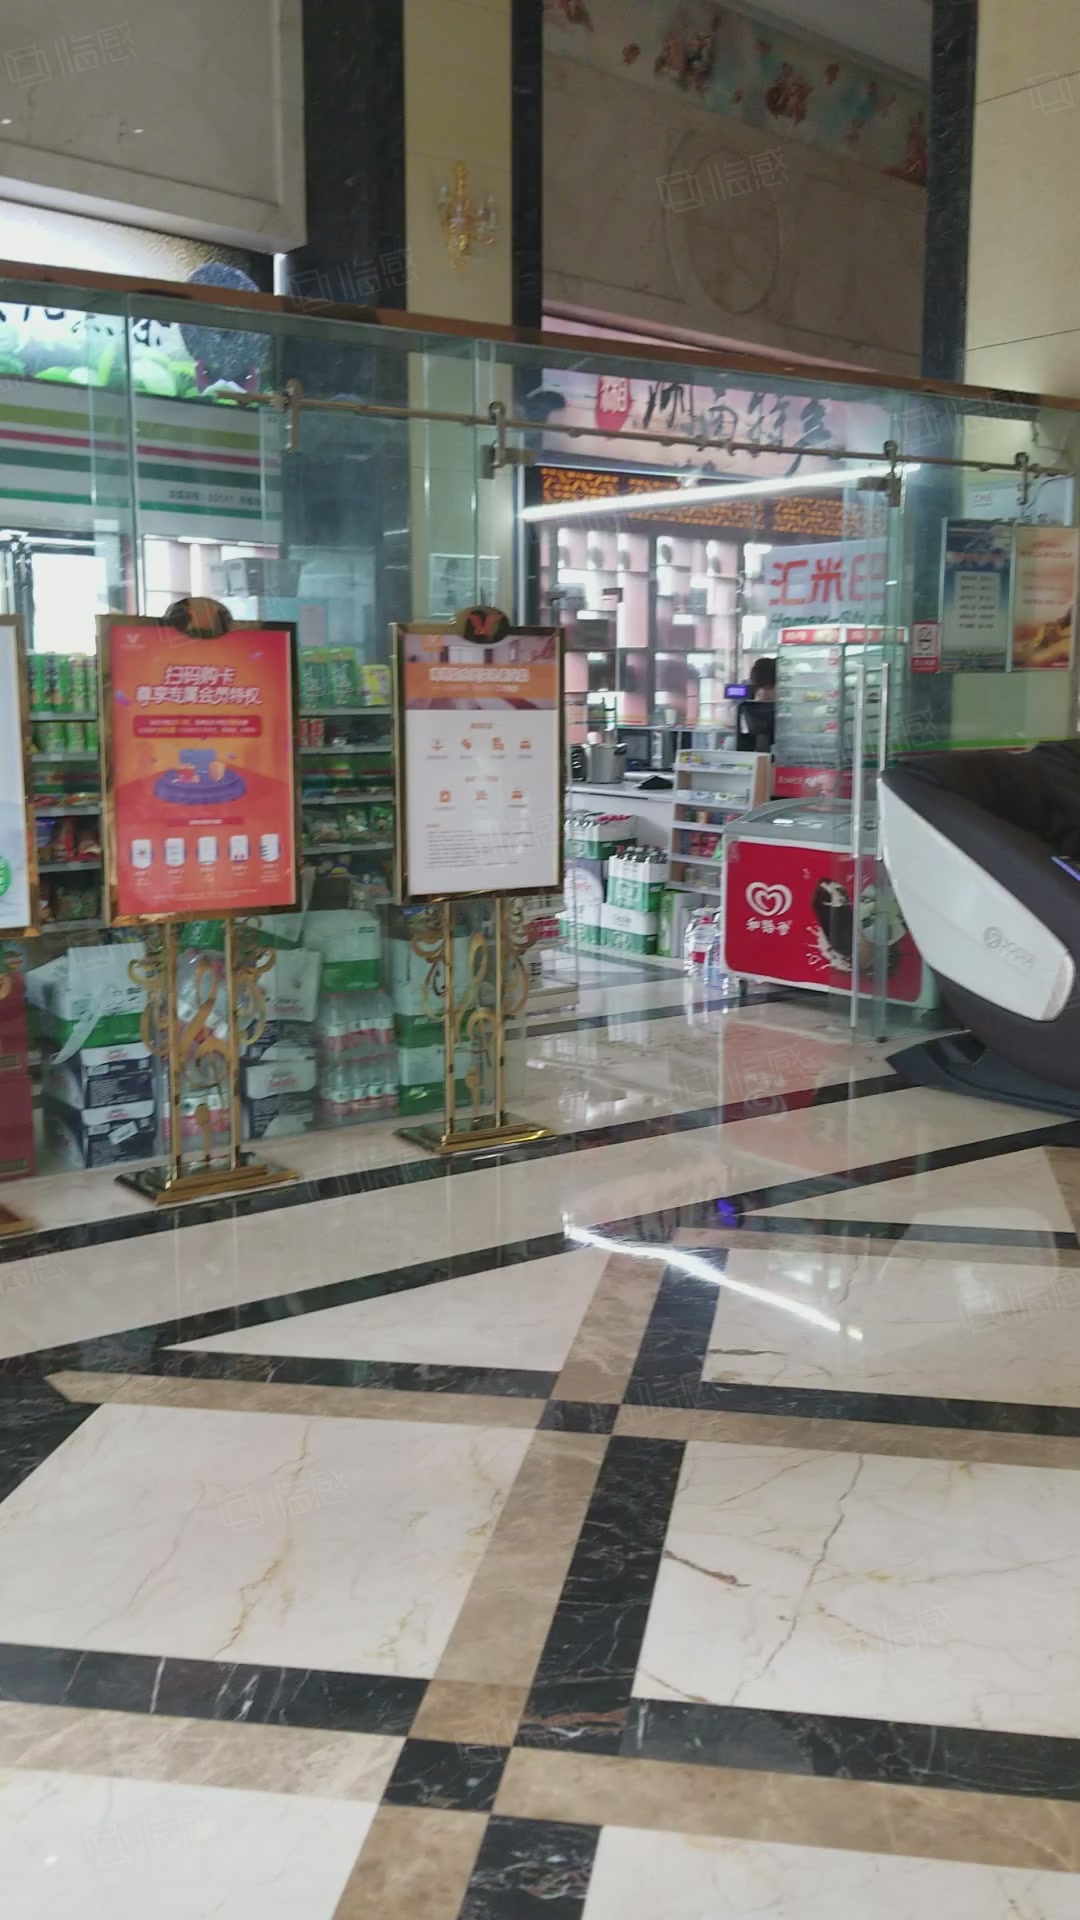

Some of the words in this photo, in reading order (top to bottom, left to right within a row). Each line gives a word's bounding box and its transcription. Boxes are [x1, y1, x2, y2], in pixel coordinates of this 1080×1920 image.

[164, 665, 237, 686] 扫码购卡
[136, 685, 263, 708] 尊享专属会员特权
